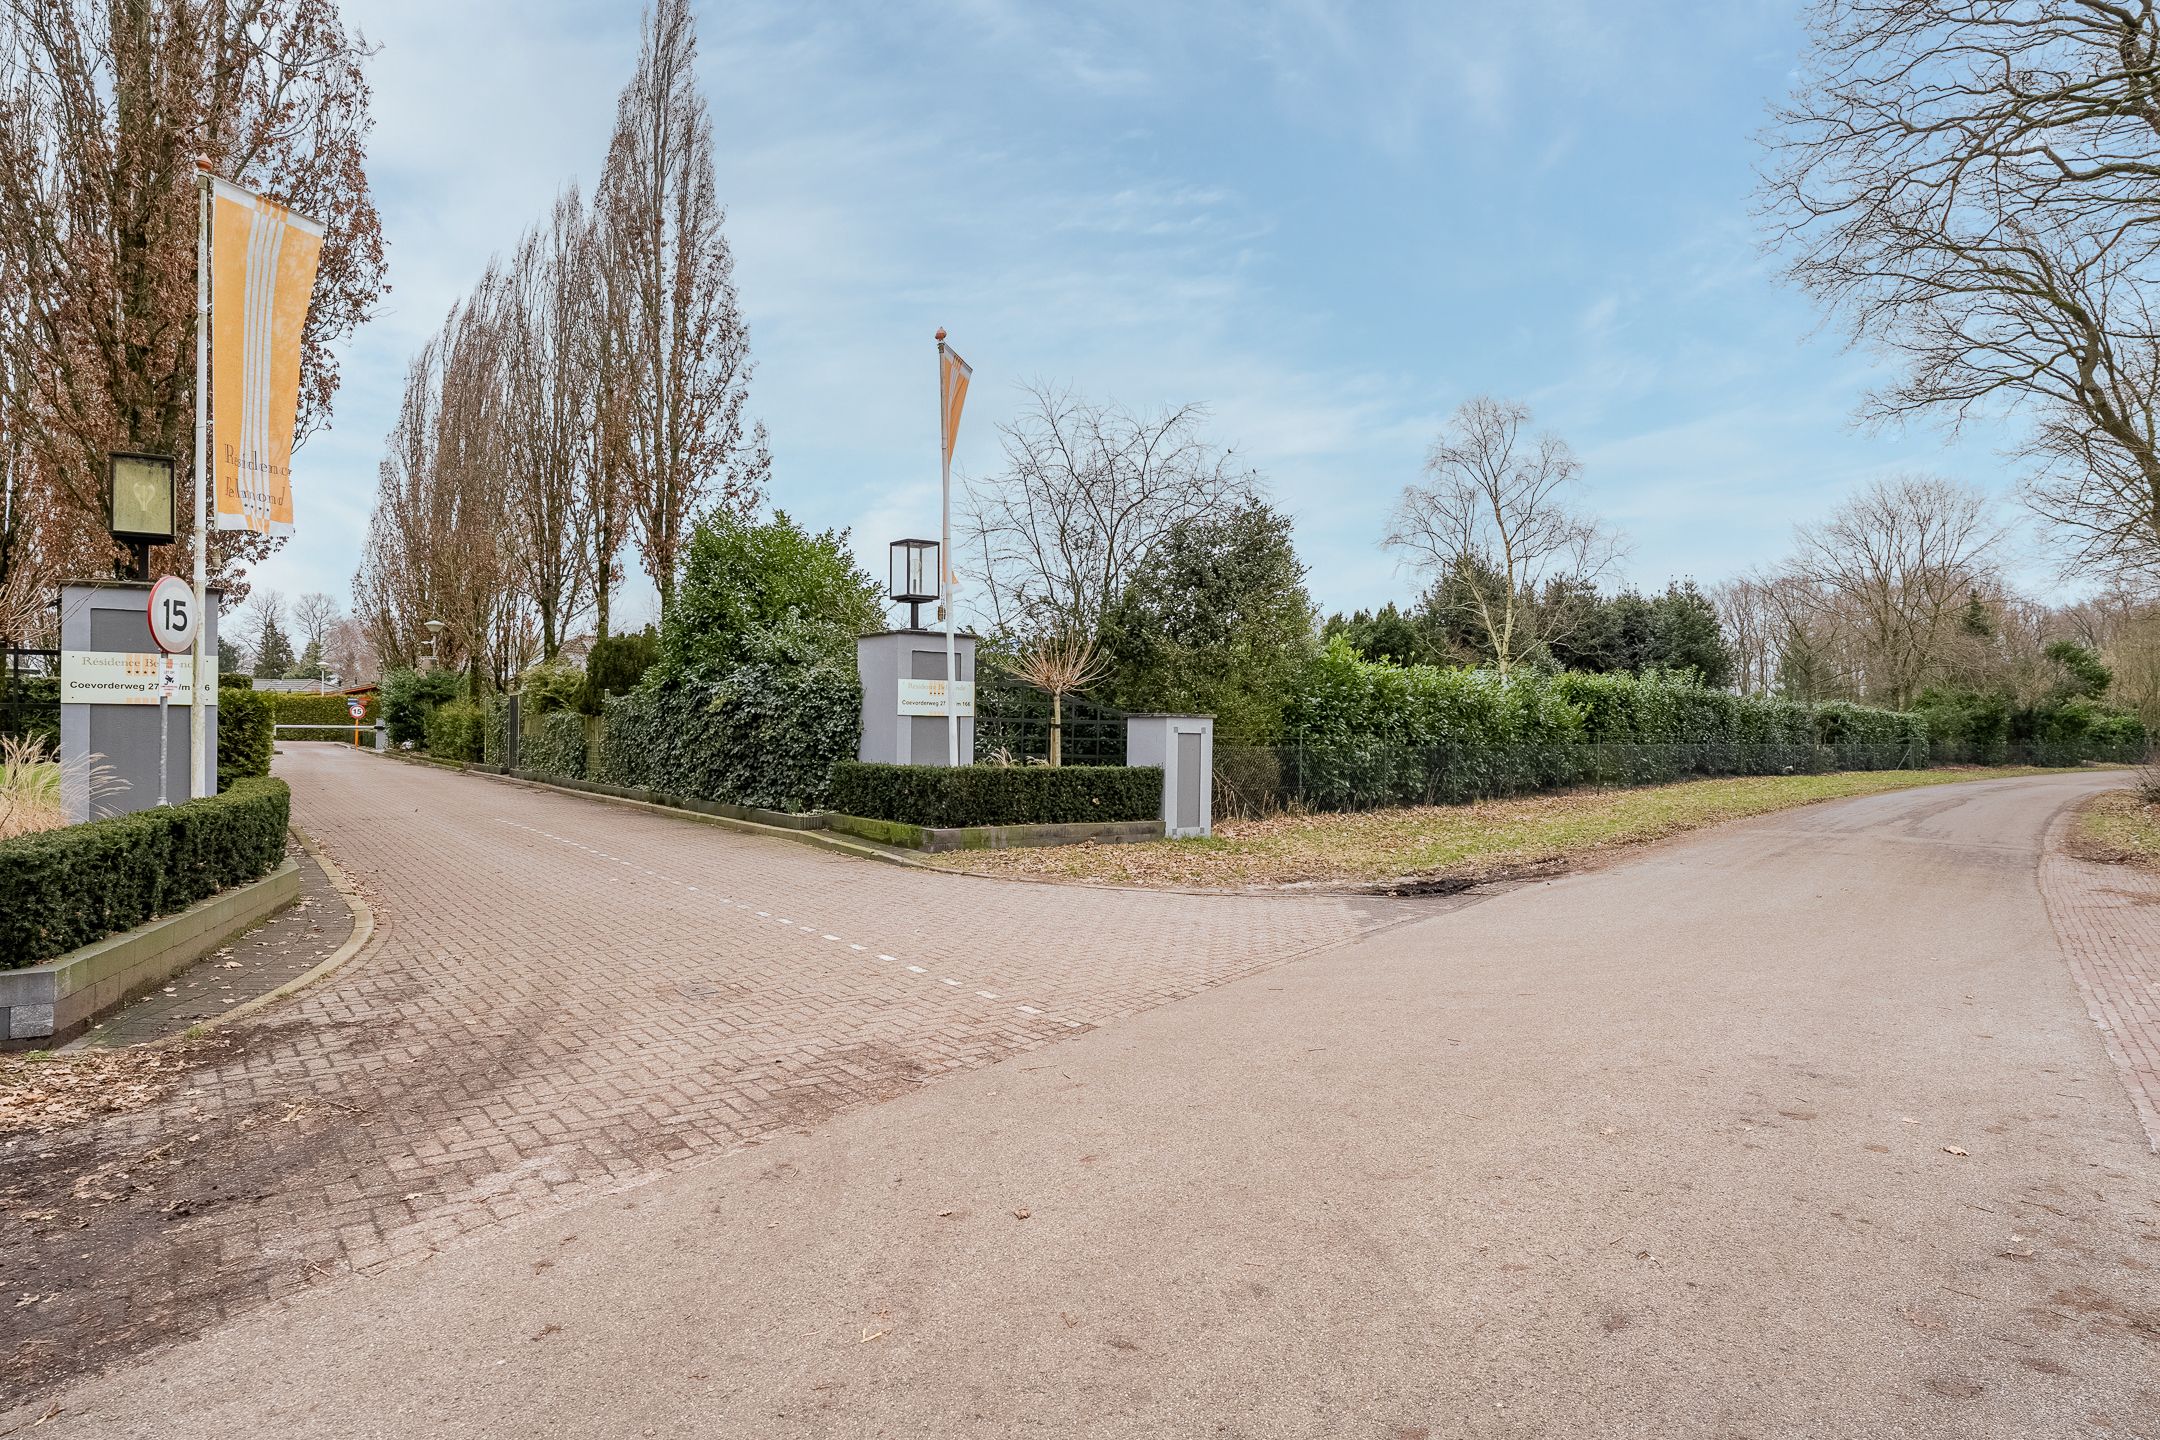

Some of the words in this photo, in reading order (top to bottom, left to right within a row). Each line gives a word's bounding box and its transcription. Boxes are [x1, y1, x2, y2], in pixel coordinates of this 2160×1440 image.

[163, 598, 188, 632] 15
[82, 656, 141, 667] Résidence
[70, 681, 145, 692] Coevorderweg
